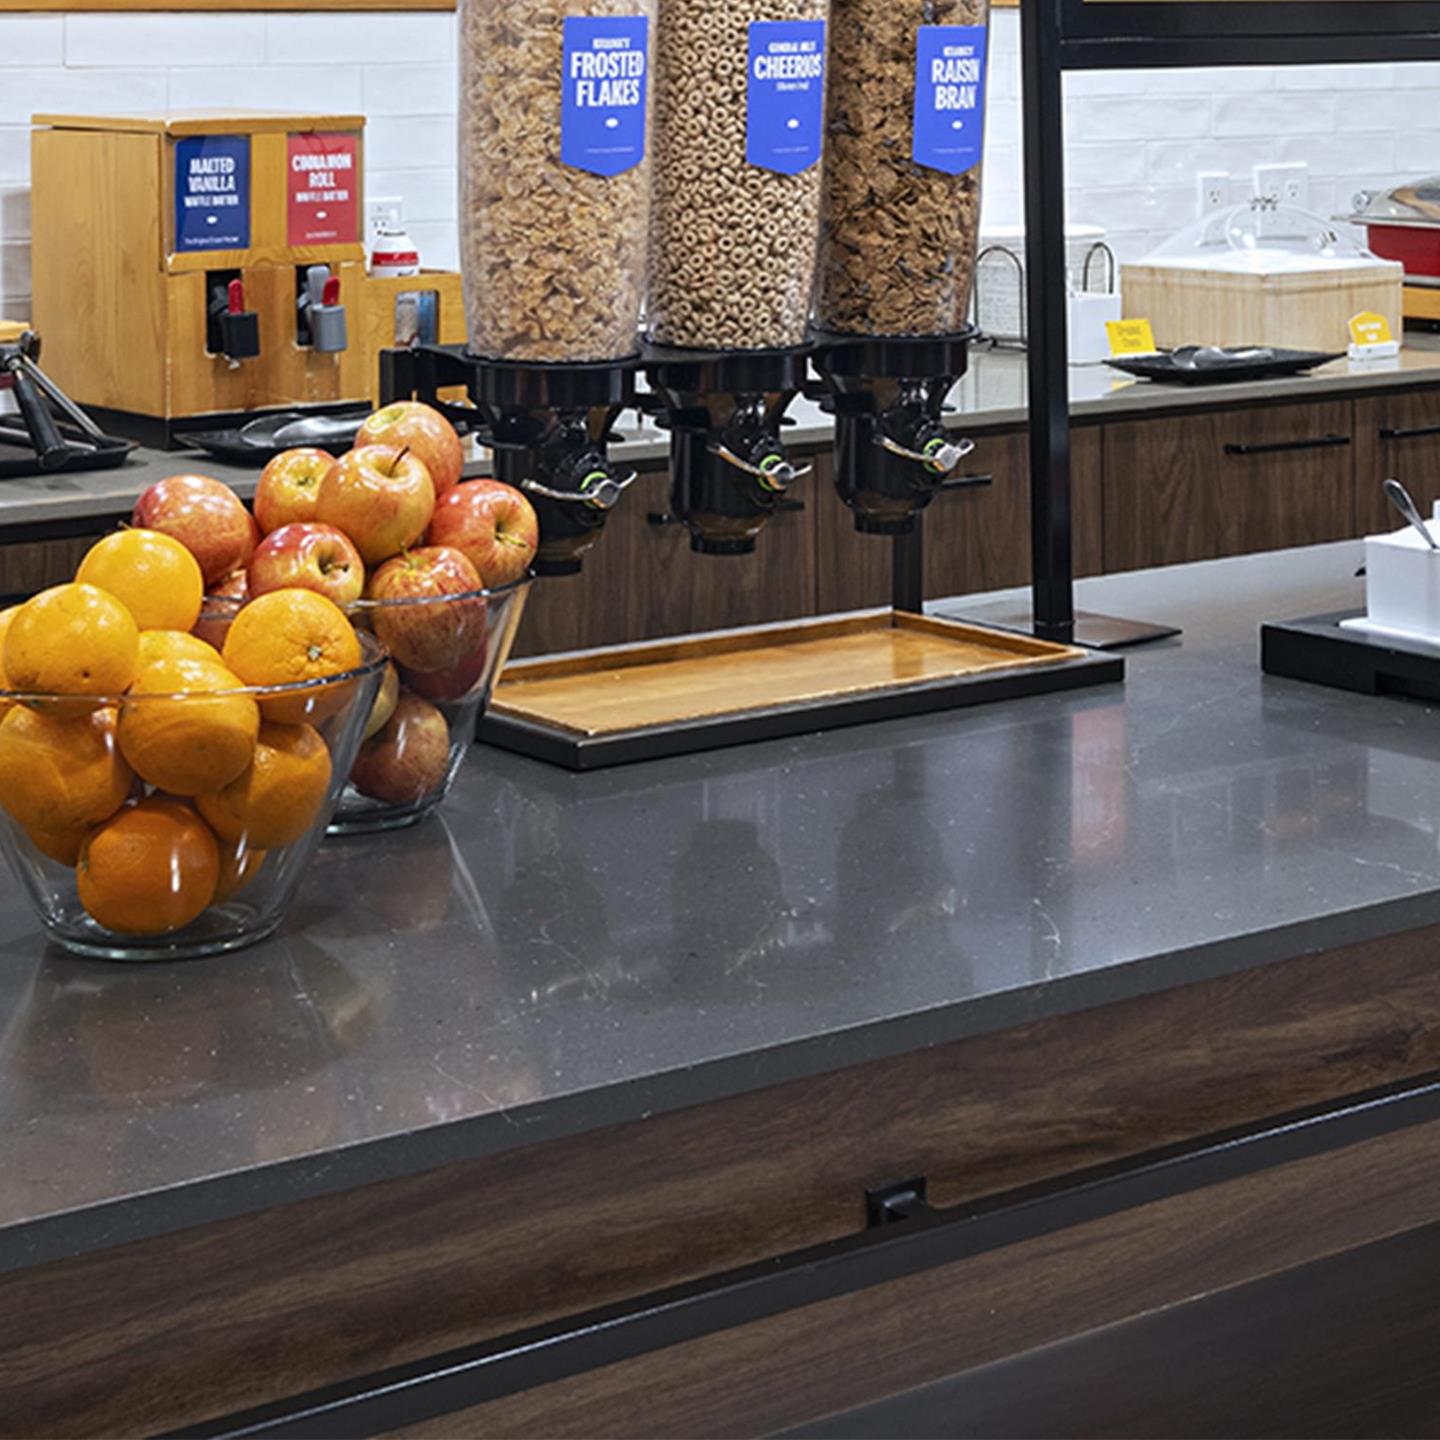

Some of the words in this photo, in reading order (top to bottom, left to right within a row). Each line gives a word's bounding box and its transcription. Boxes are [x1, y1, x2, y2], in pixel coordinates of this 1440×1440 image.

[570, 50, 644, 78] FROSTED
[754, 54, 821, 80] CHEERIOS
[931, 58, 980, 84] RAISIN
[576, 79, 640, 107] FLAKES
[935, 85, 976, 110] BRAN
[190, 157, 236, 174] MALTED
[292, 153, 353, 172] CINNAMON
[188, 175, 236, 193] VANILLA
[308, 171, 336, 188] ROLL
